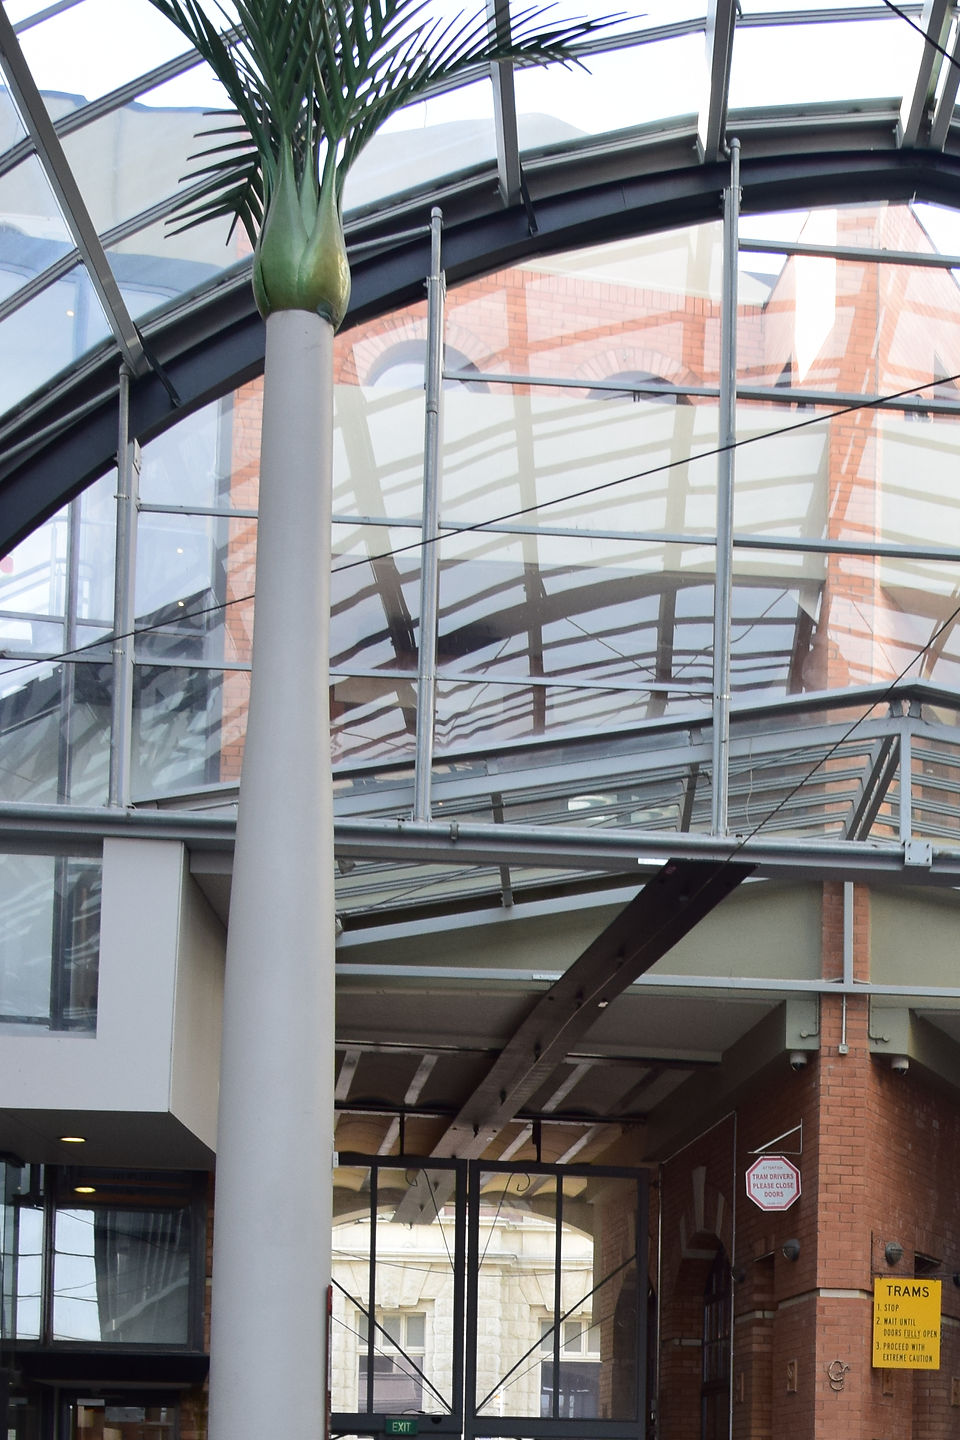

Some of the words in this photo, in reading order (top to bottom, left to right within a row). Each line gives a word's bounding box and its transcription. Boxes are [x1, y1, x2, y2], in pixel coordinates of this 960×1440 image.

[887, 1285, 930, 1298] TRAMS
[884, 1303, 899, 1312] STOP
[883, 1317, 897, 1326] WAIT
[900, 1318, 916, 1327] UNTIL
[883, 1329, 902, 1337] DOORS
[903, 1329, 920, 1338] FULLY
[923, 1330, 938, 1338] OPEN
[883, 1342, 909, 1351] PROCEED
[911, 1343, 925, 1351] WITH
[883, 1353, 906, 1362] EXTREME
[909, 1354, 933, 1363] CAUTION
[392, 1421, 411, 1432] EXIT
